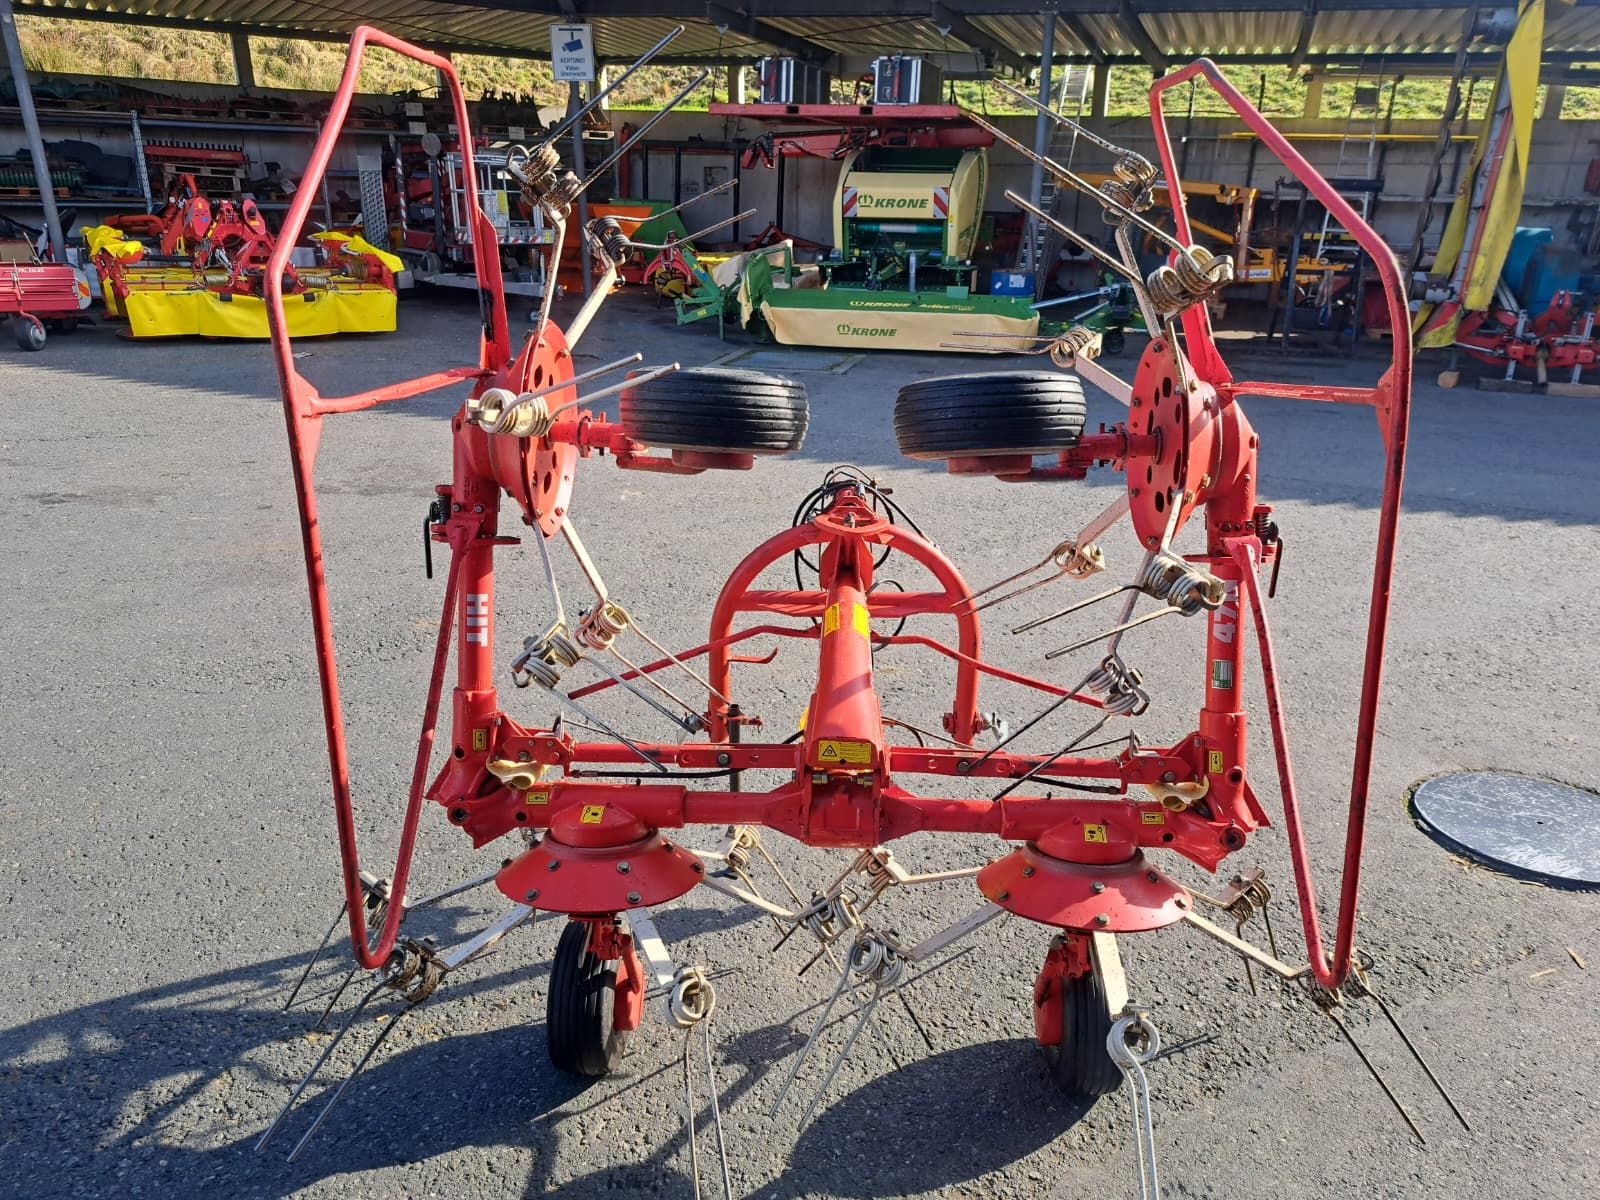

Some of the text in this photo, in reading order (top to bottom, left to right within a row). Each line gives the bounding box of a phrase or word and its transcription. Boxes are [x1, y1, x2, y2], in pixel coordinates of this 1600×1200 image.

[874, 198, 929, 209] KRONE
[850, 327, 897, 338] KRONE
[466, 593, 489, 647] HIT
